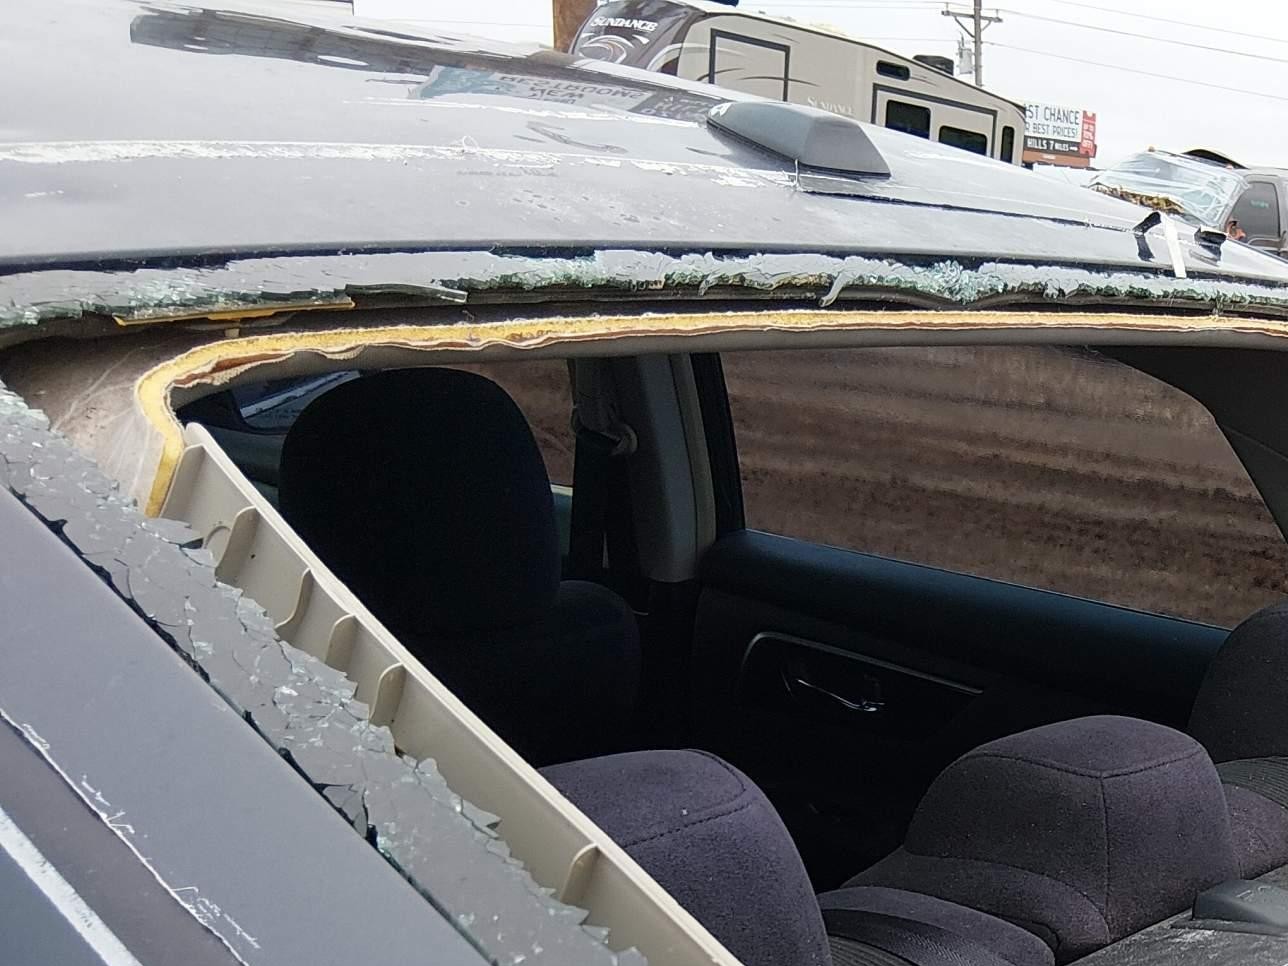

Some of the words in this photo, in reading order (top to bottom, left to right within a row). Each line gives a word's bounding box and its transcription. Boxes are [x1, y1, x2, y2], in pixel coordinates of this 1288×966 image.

[590, 16, 658, 32] SUNDANCE
[1044, 106, 1079, 125] CHANCE
[1033, 123, 1050, 135] BEST
[1052, 125, 1077, 138] PRICES!
[1027, 138, 1047, 149] HILLS
[1049, 140, 1054, 150] 7
